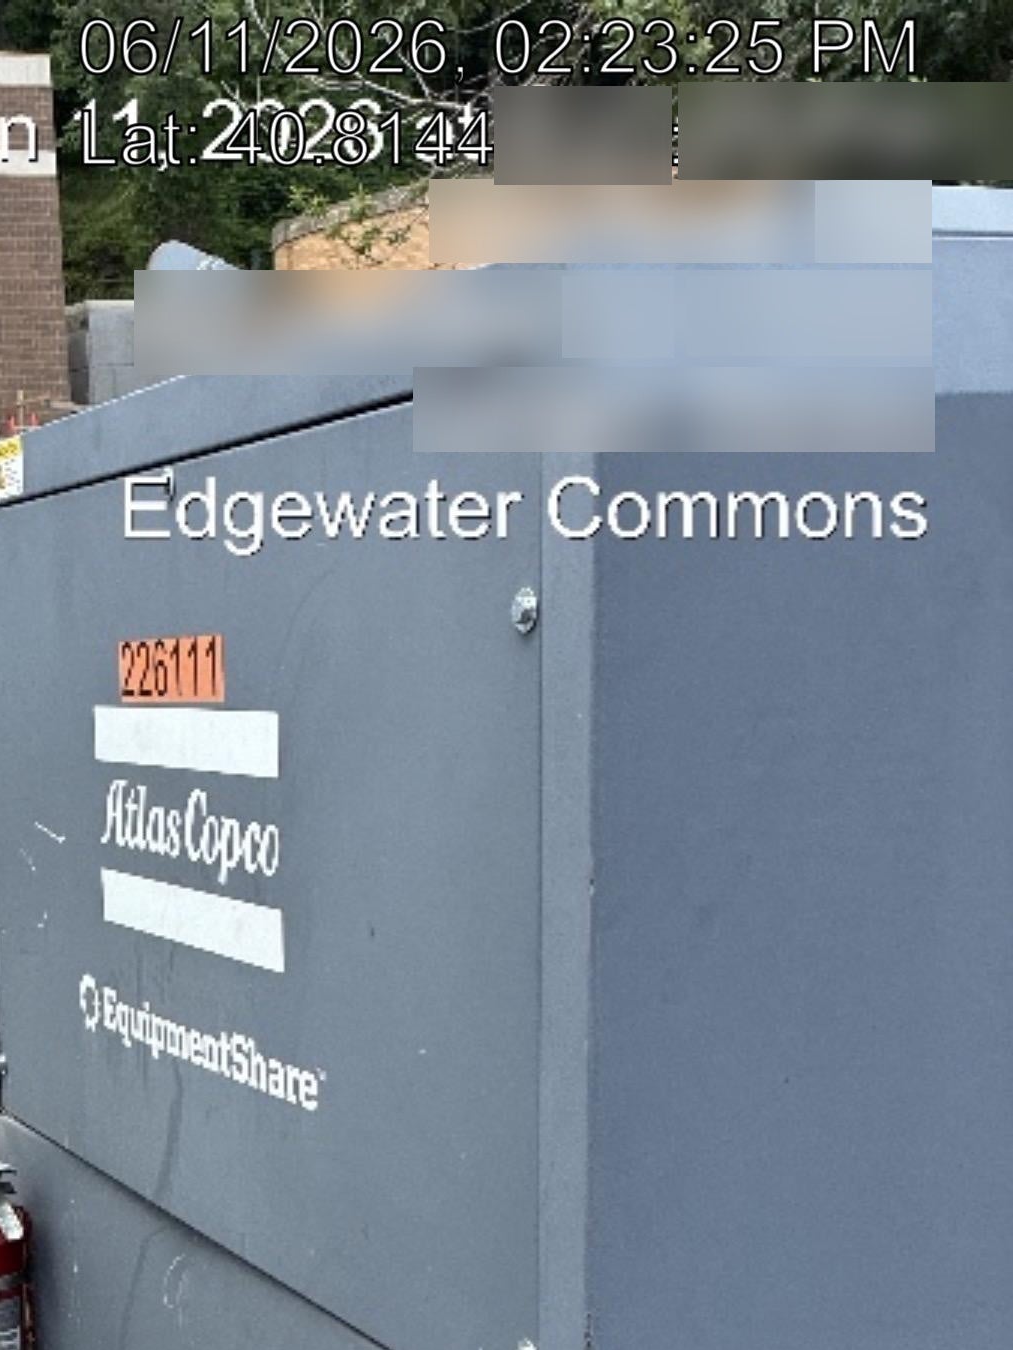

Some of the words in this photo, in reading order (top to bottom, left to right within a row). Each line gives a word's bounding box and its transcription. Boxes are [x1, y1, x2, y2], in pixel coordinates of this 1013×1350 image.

[121, 635, 218, 698] 226111
[100, 779, 182, 859] Atlas
[185, 788, 279, 885] Copco
[102, 985, 320, 1112] EquipmentShare
